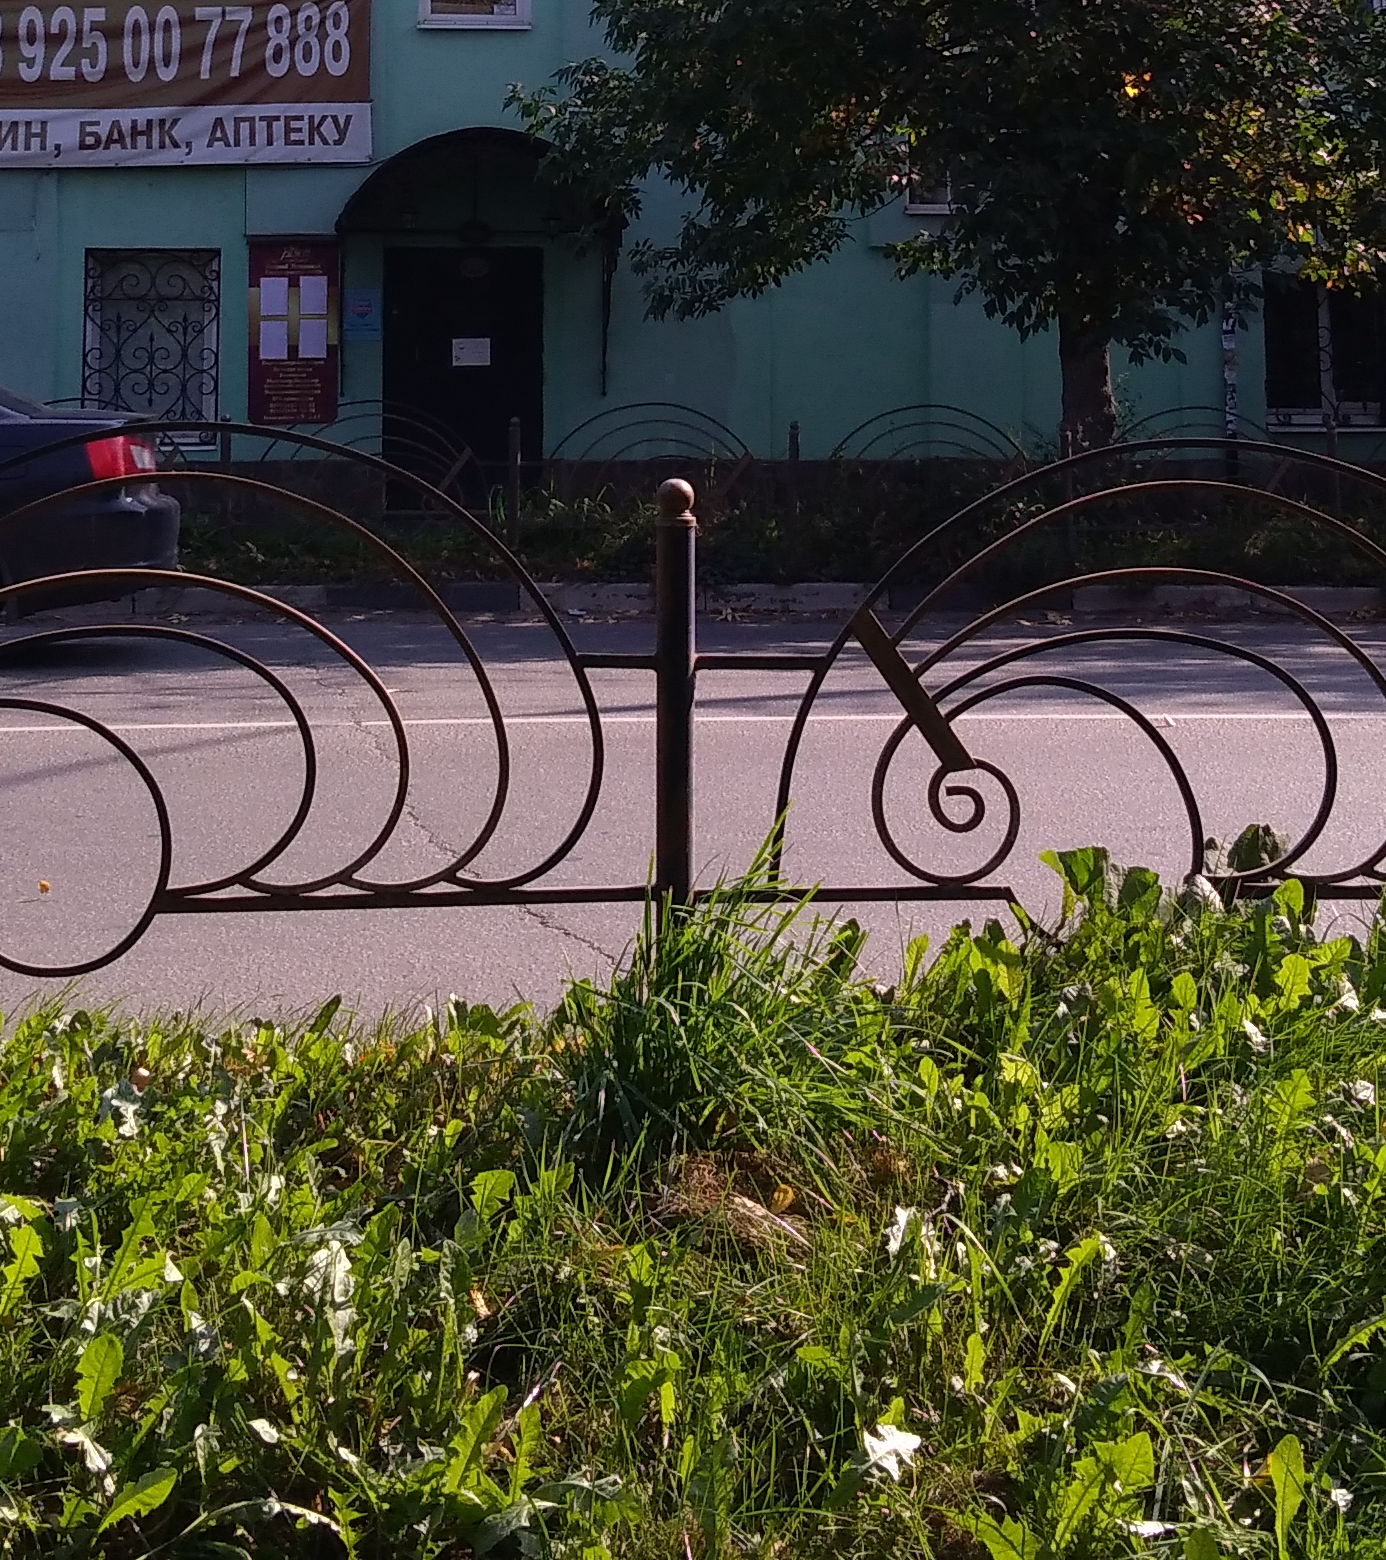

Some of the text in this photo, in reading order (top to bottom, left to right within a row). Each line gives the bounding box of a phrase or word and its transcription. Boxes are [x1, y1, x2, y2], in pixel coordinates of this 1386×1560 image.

[17, 5, 108, 82] 925
[123, 5, 181, 82] 00
[195, 5, 254, 80] 77
[265, 0, 351, 78] 888
[78, 118, 193, 157] БАНК,
[206, 114, 353, 149] АПТЕКУ
